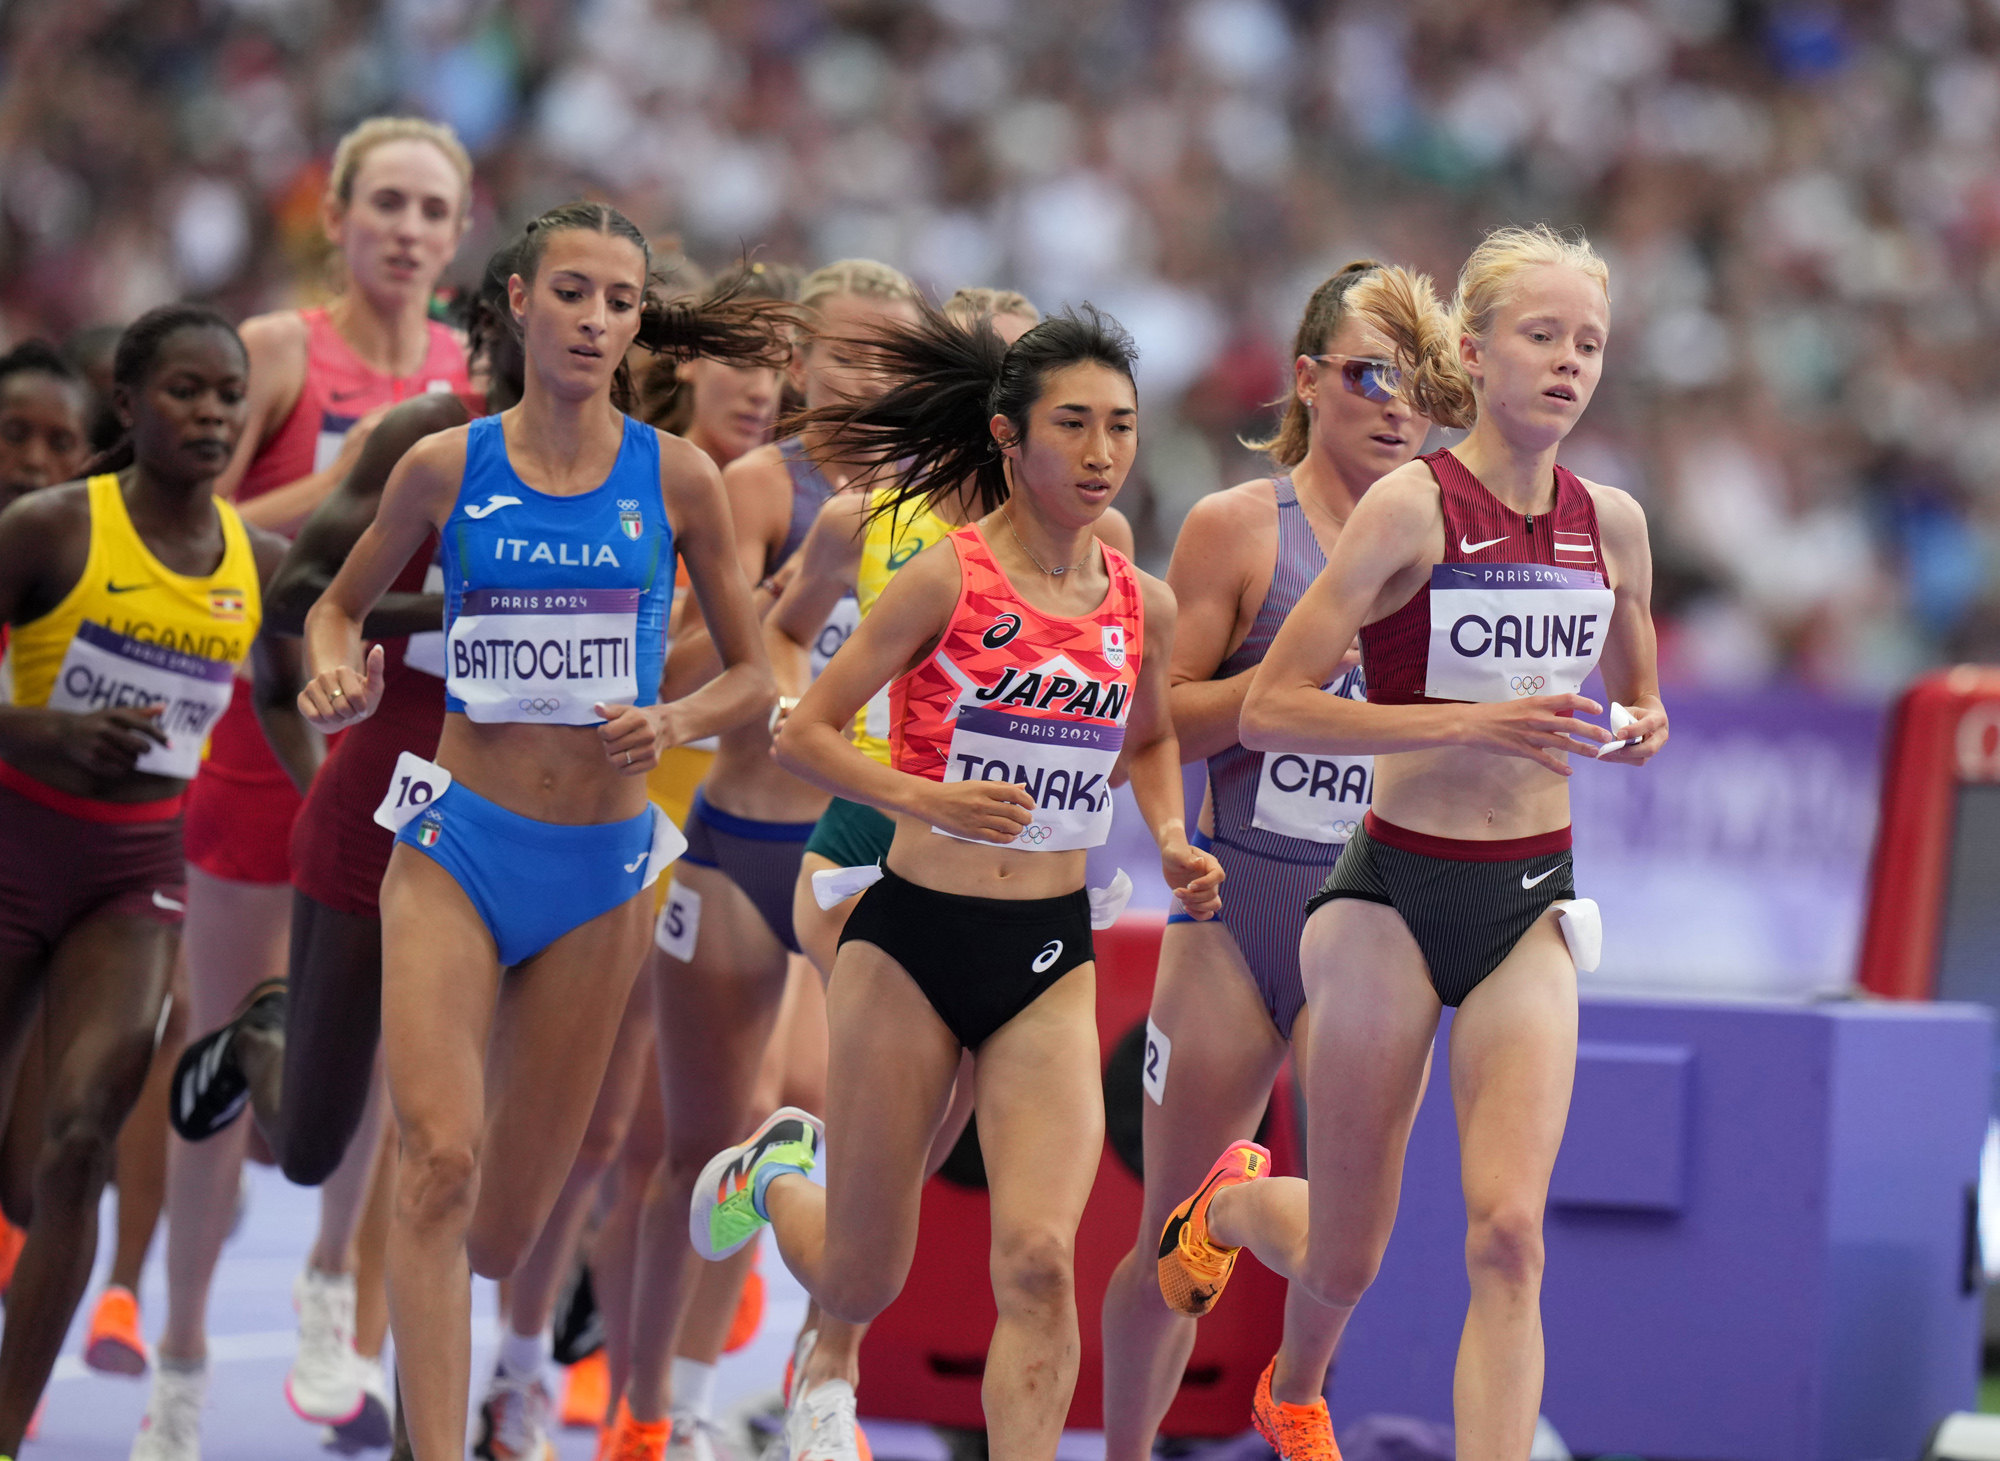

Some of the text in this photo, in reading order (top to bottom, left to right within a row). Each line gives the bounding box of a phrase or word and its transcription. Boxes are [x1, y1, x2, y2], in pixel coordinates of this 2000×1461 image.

[495, 538, 620, 567] ITALIA
[1484, 570, 1569, 584] PARIS 2024
[490, 596, 588, 609] PARIS 2024
[1450, 614, 1598, 659] CAUNE
[454, 637, 629, 680] BATTOCLETTI
[975, 667, 1129, 721] JAPAN
[1009, 720, 1101, 742] PARIS 2024
[395, 775, 433, 809] 10
[1270, 754, 1375, 805] CRA
[664, 902, 685, 939] 5
